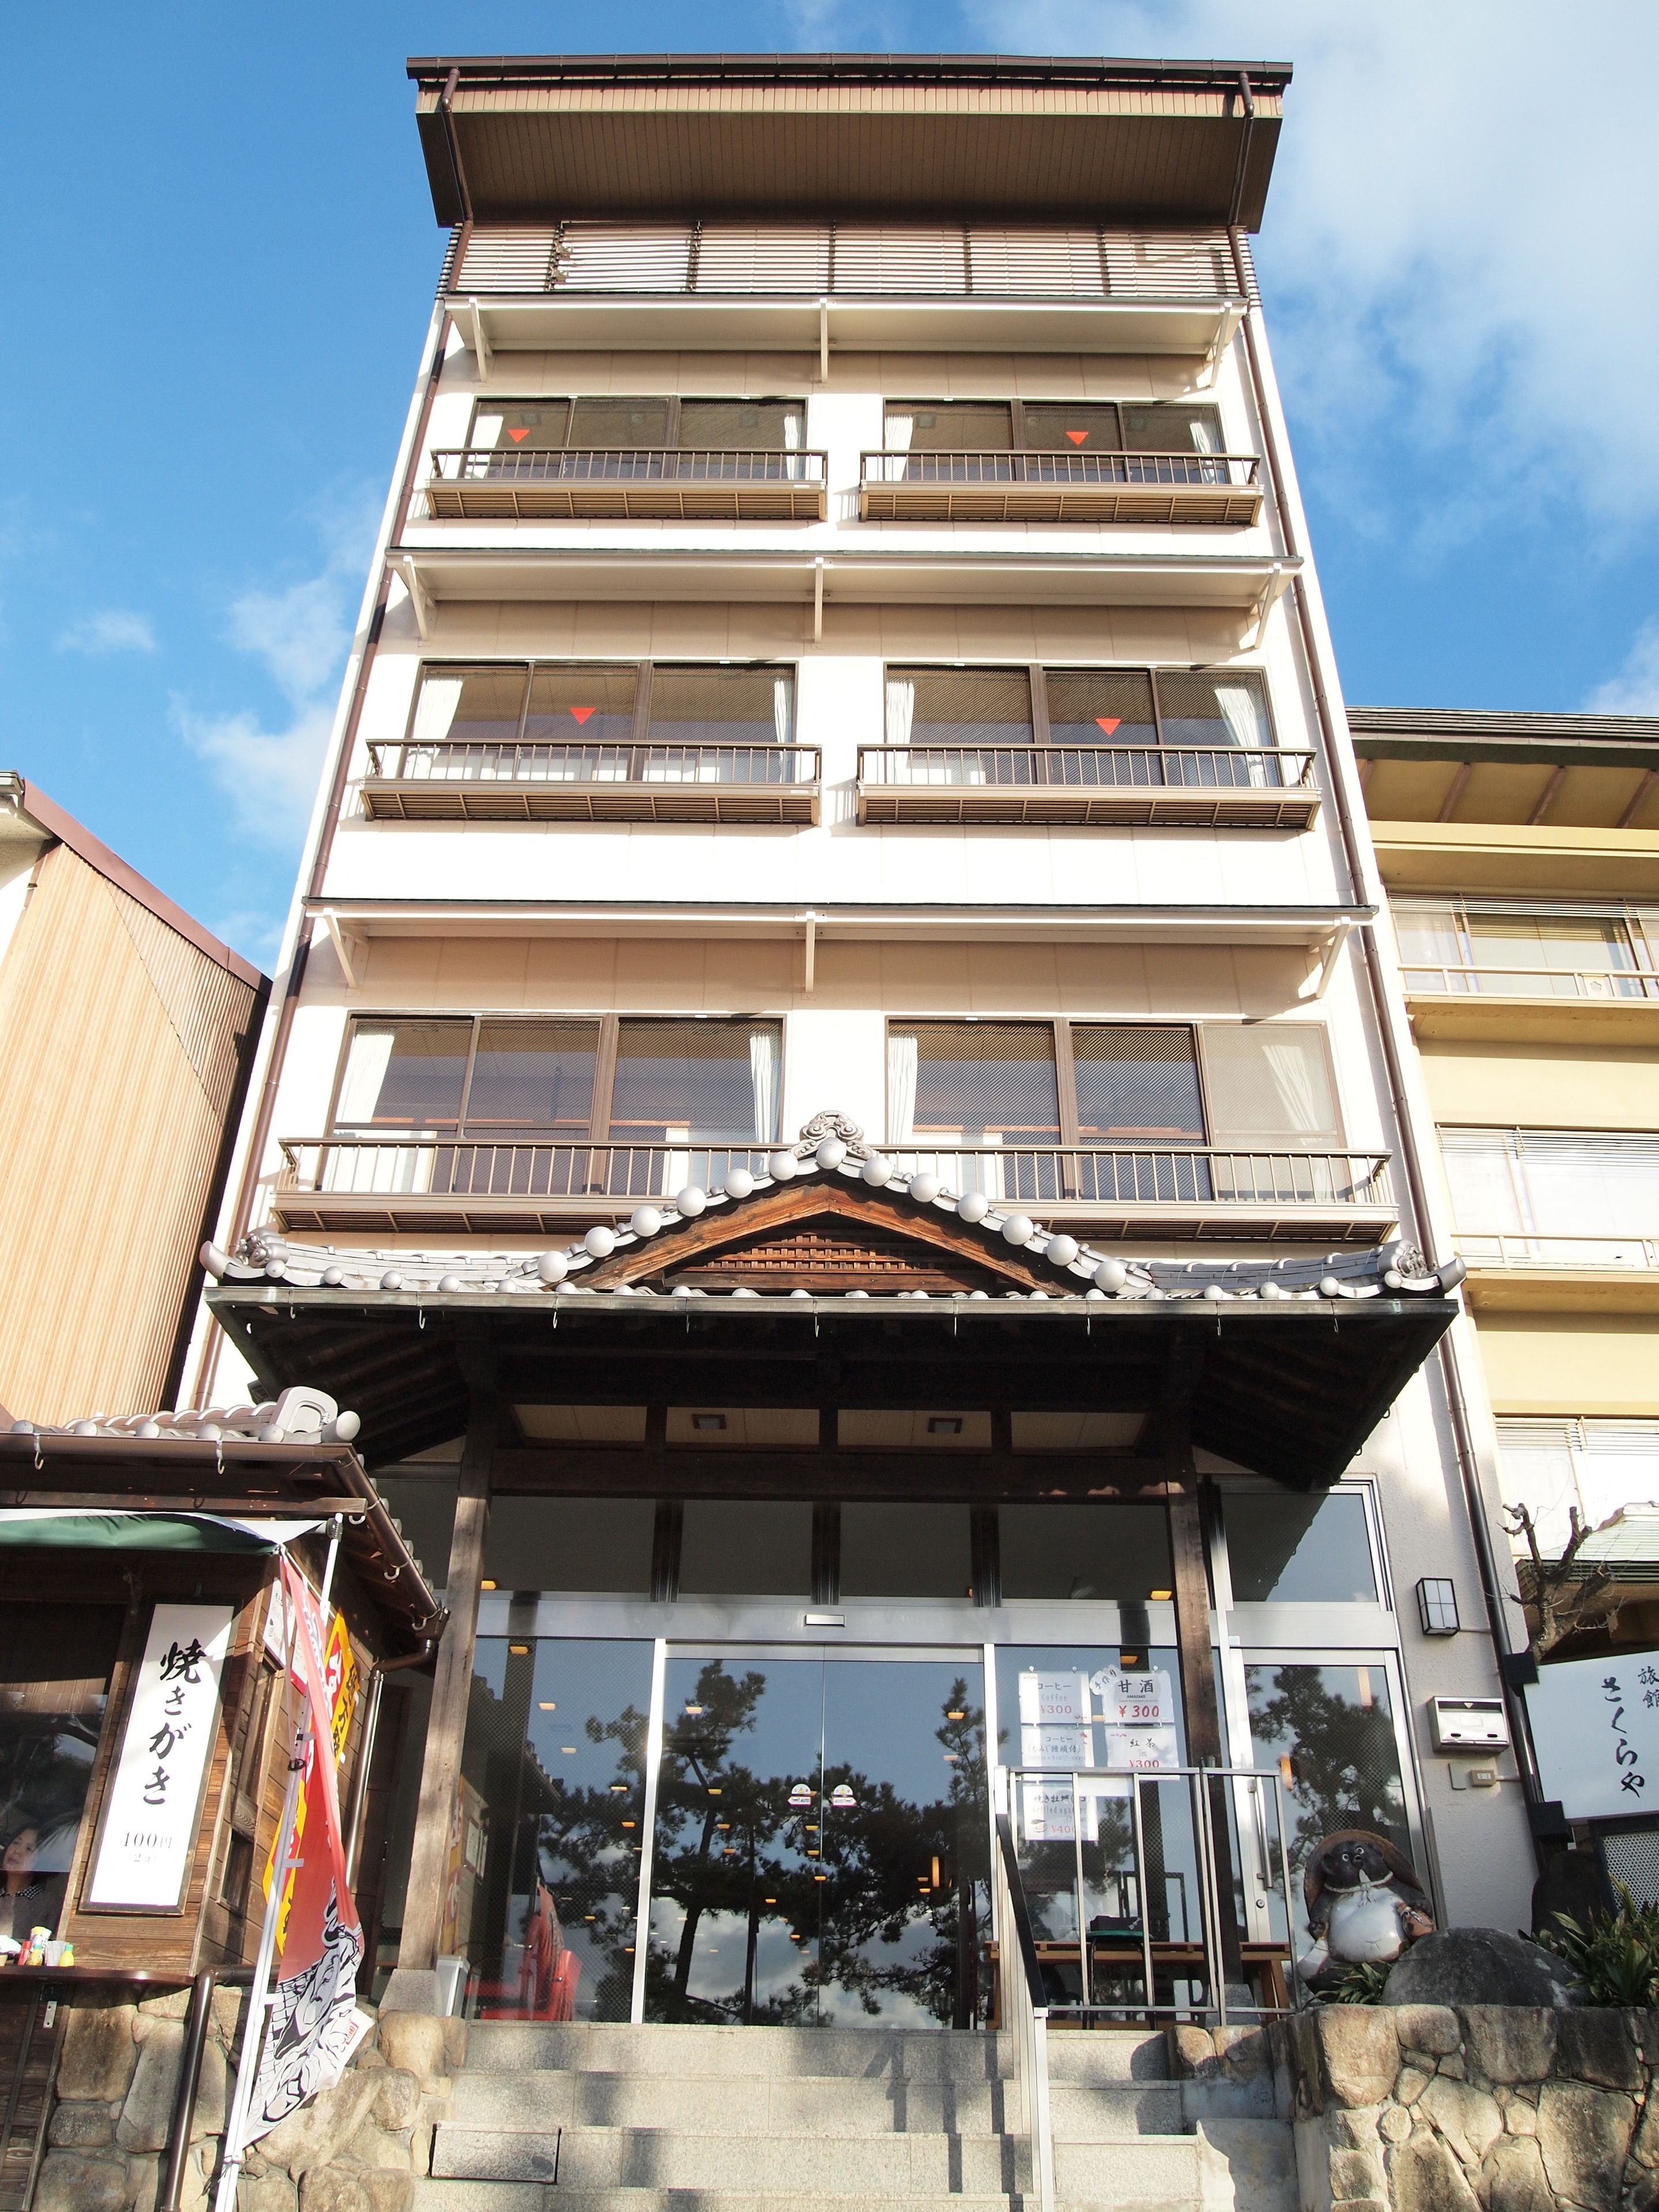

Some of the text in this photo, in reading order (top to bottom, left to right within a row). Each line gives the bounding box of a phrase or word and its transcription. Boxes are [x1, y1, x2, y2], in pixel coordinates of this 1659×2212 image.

[1037, 1682, 1071, 1691] コーヒー
[1118, 1679, 1154, 1694] 甘酒
[1041, 1693, 1067, 1701] Coffee
[1041, 1705, 1072, 1714] ¥300
[142, 1638, 207, 1805] 焼きがき
[1601, 1676, 1645, 1798] さくらや
[1130, 1737, 1156, 1748] 紅茶
[1130, 1760, 1160, 1768] ¥300
